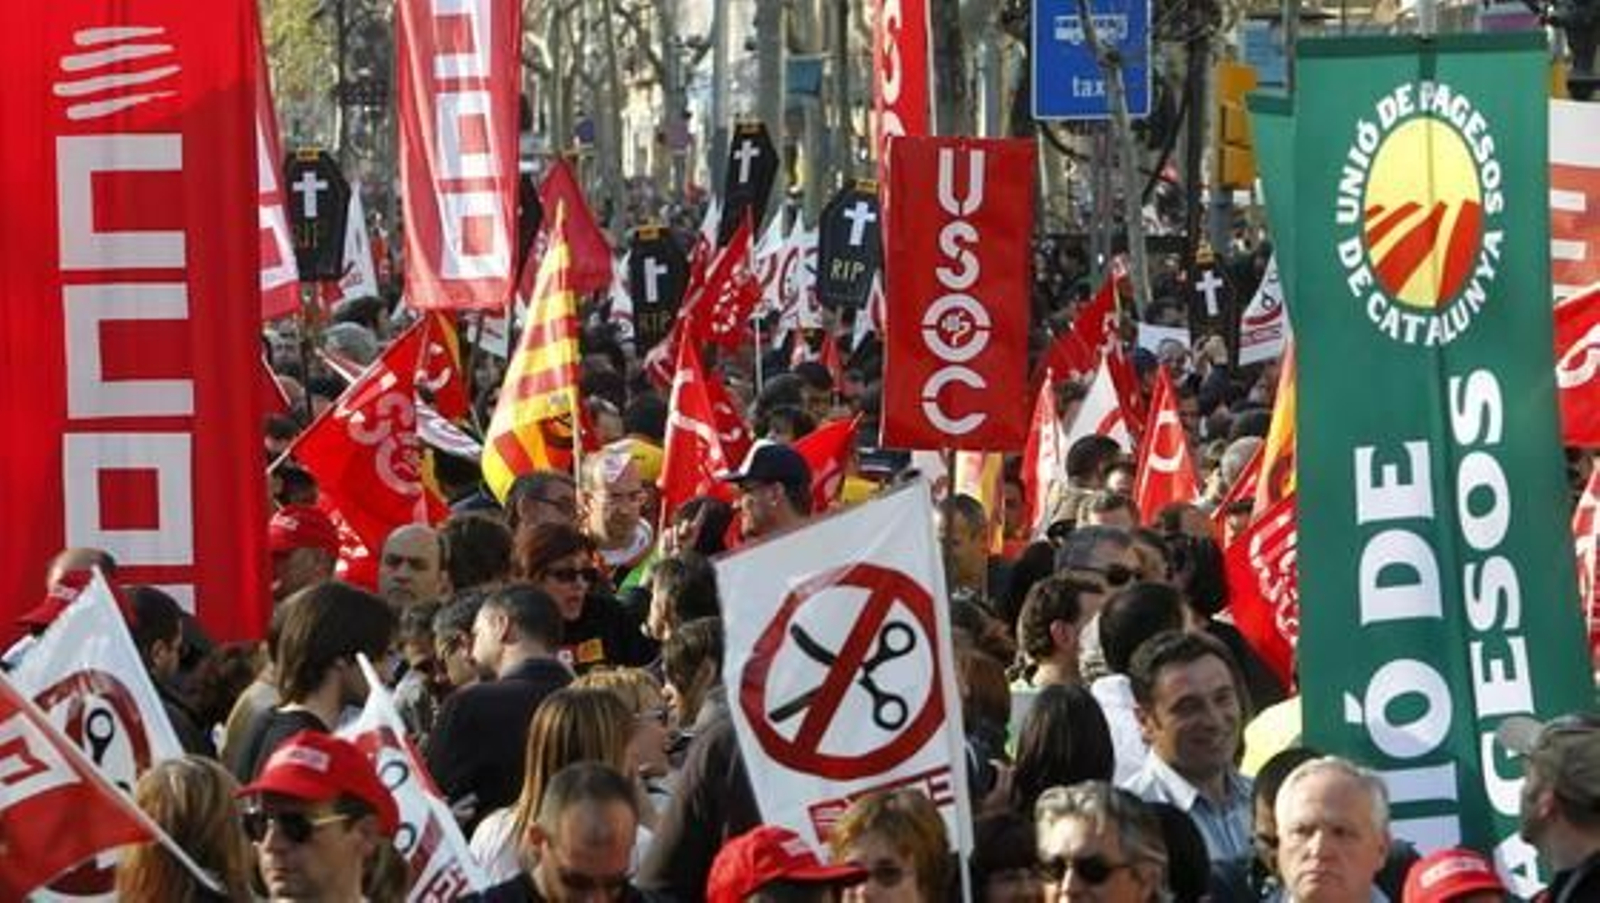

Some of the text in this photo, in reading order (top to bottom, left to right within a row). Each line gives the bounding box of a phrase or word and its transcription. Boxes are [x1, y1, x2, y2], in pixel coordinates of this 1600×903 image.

[1072, 75, 1106, 98] tax
[1336, 80, 1504, 224] UNIÓ DE PAGESOS
[830, 258, 866, 283] RIP
[921, 147, 992, 436] USOC
[1337, 235, 1373, 297] DE
[1367, 229, 1503, 346] CATALUNYA
[56, 133, 194, 614] CCO
[1354, 440, 1443, 625] DE
[1345, 658, 1461, 860] IÓ
